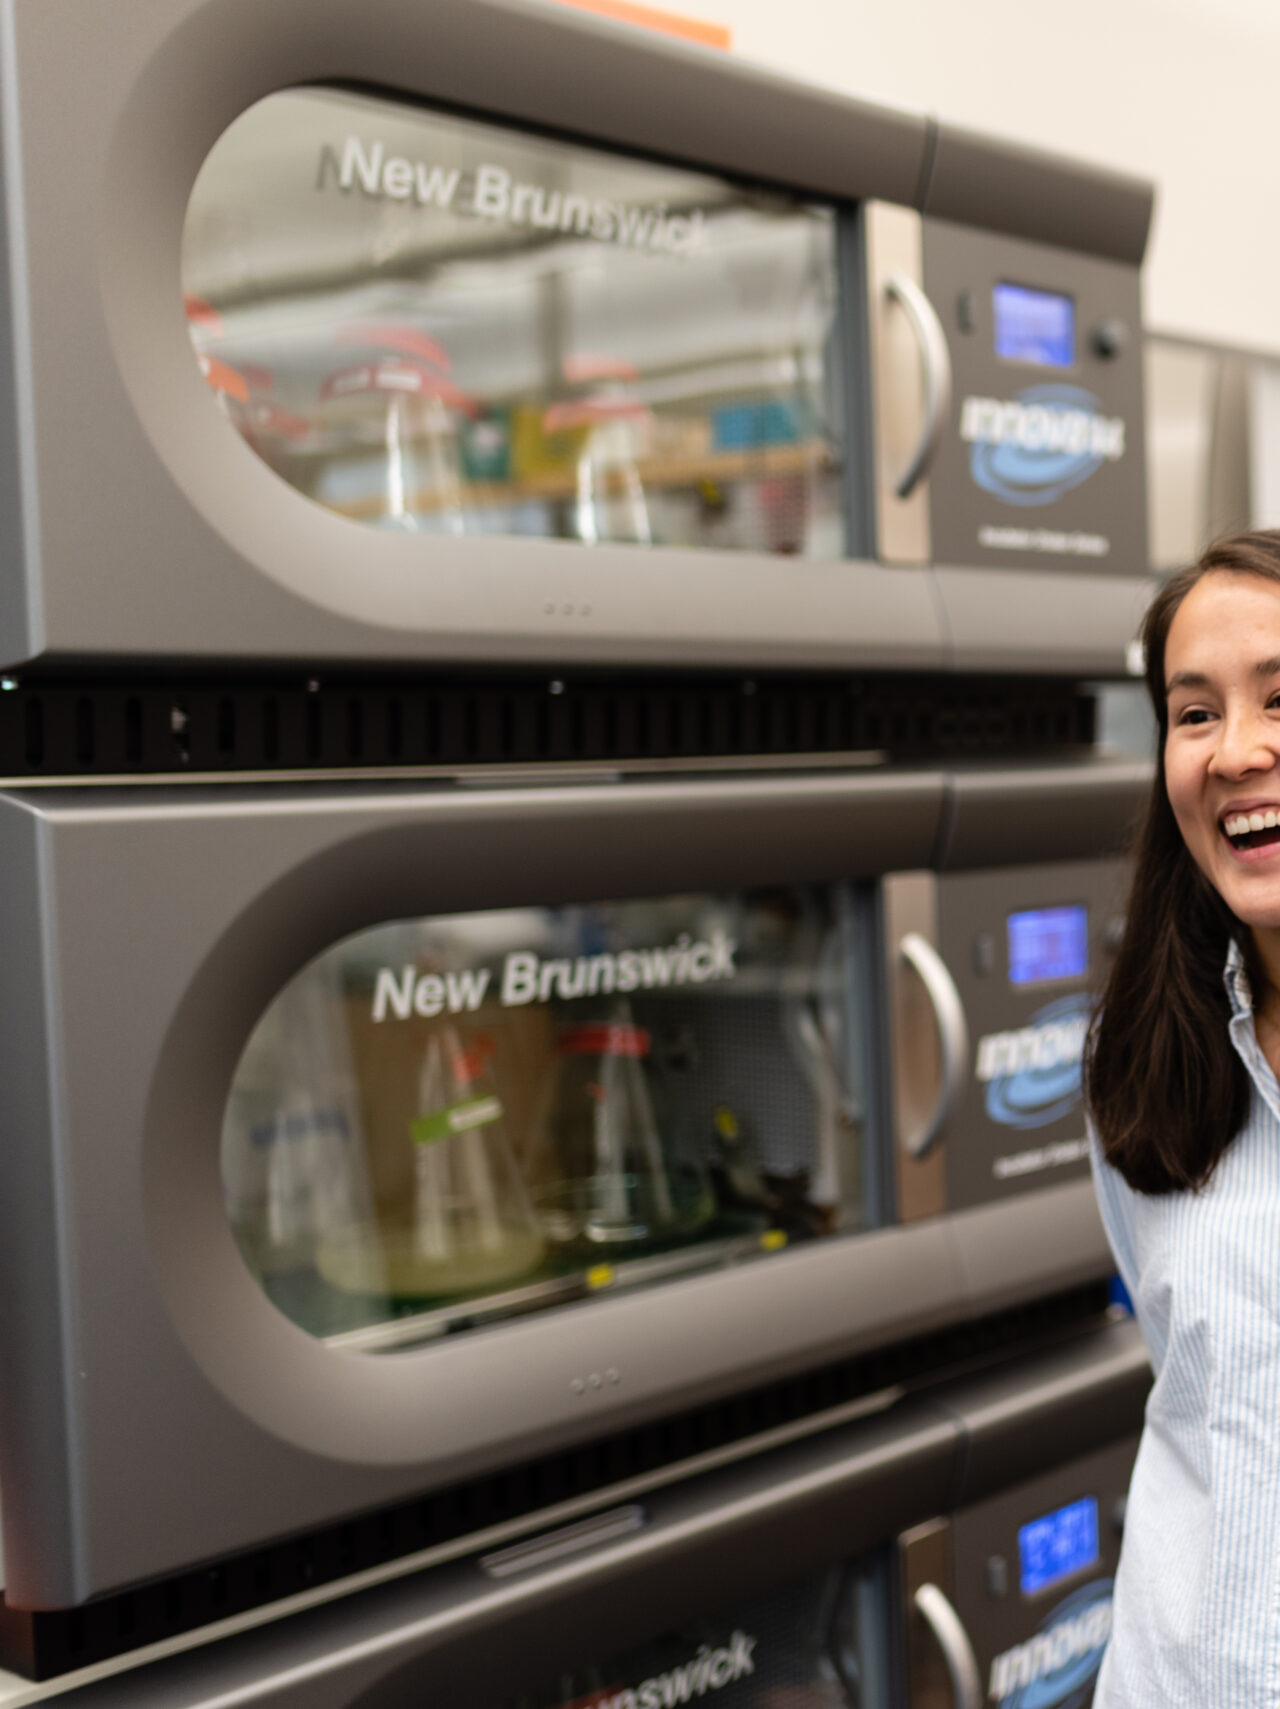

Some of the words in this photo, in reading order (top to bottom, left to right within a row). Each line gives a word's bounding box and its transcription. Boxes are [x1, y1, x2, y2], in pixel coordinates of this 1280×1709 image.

[339, 136, 460, 208] New
[472, 163, 709, 253] Brunswick
[372, 964, 491, 1023] New
[502, 930, 737, 1007] Brunswick
